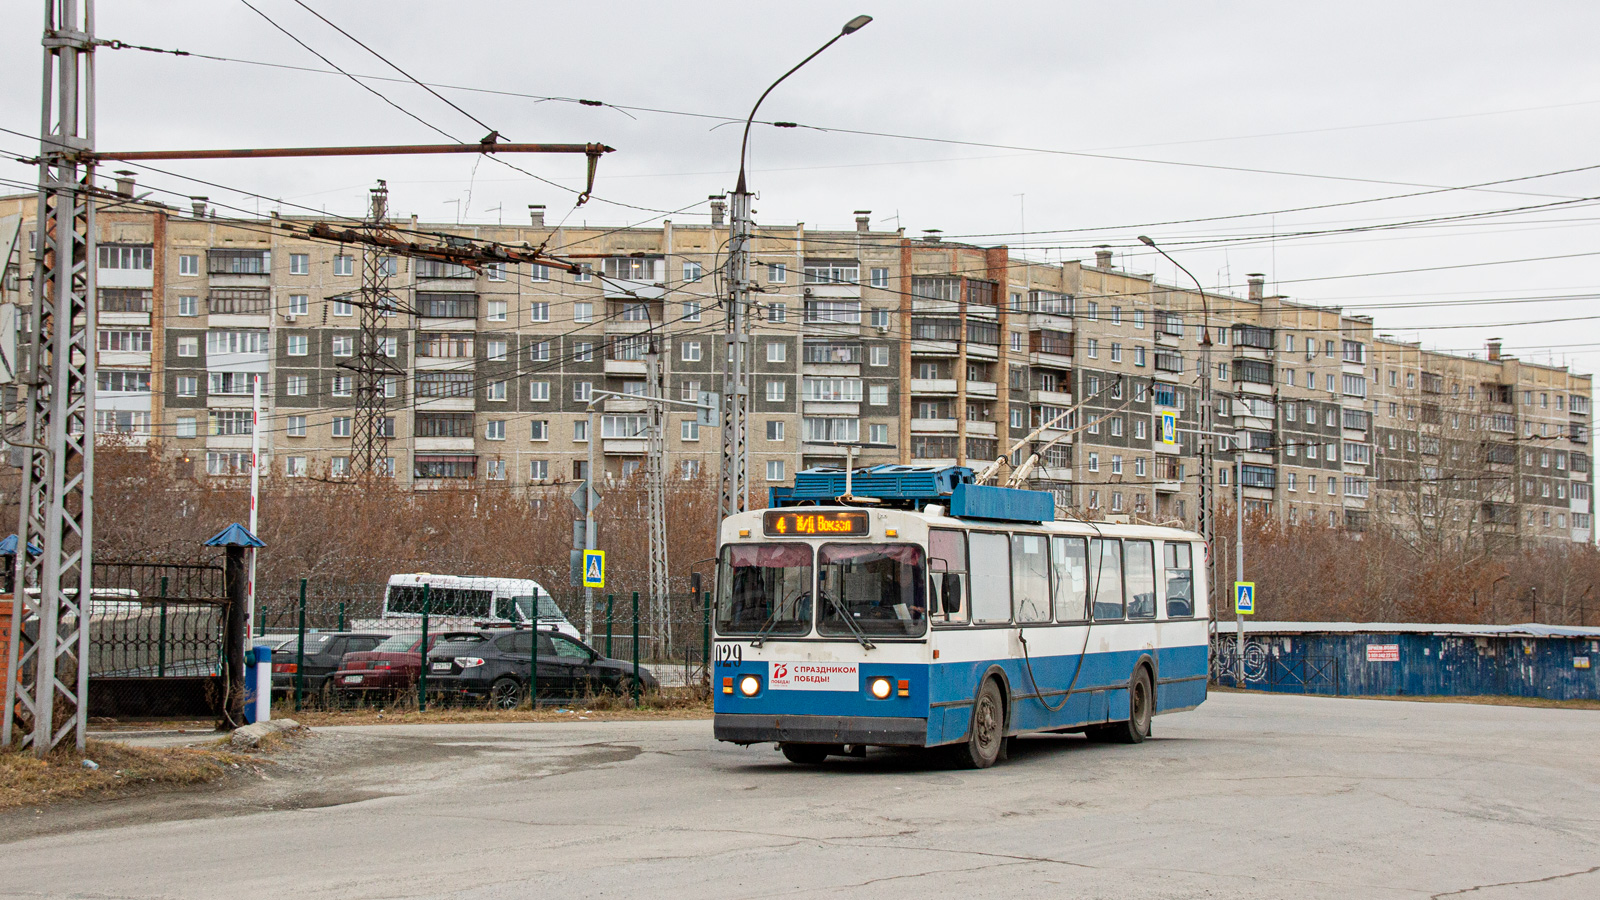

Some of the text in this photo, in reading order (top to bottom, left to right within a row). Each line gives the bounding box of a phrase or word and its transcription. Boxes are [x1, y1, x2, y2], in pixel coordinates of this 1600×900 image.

[776, 516, 787, 534] 4
[796, 515, 815, 534] Ж/Д
[715, 643, 742, 668] 029
[773, 663, 788, 679] 75
[800, 666, 857, 674] ПРАЗДНИКОМ
[794, 675, 830, 683] ПОБЕДЫ!
